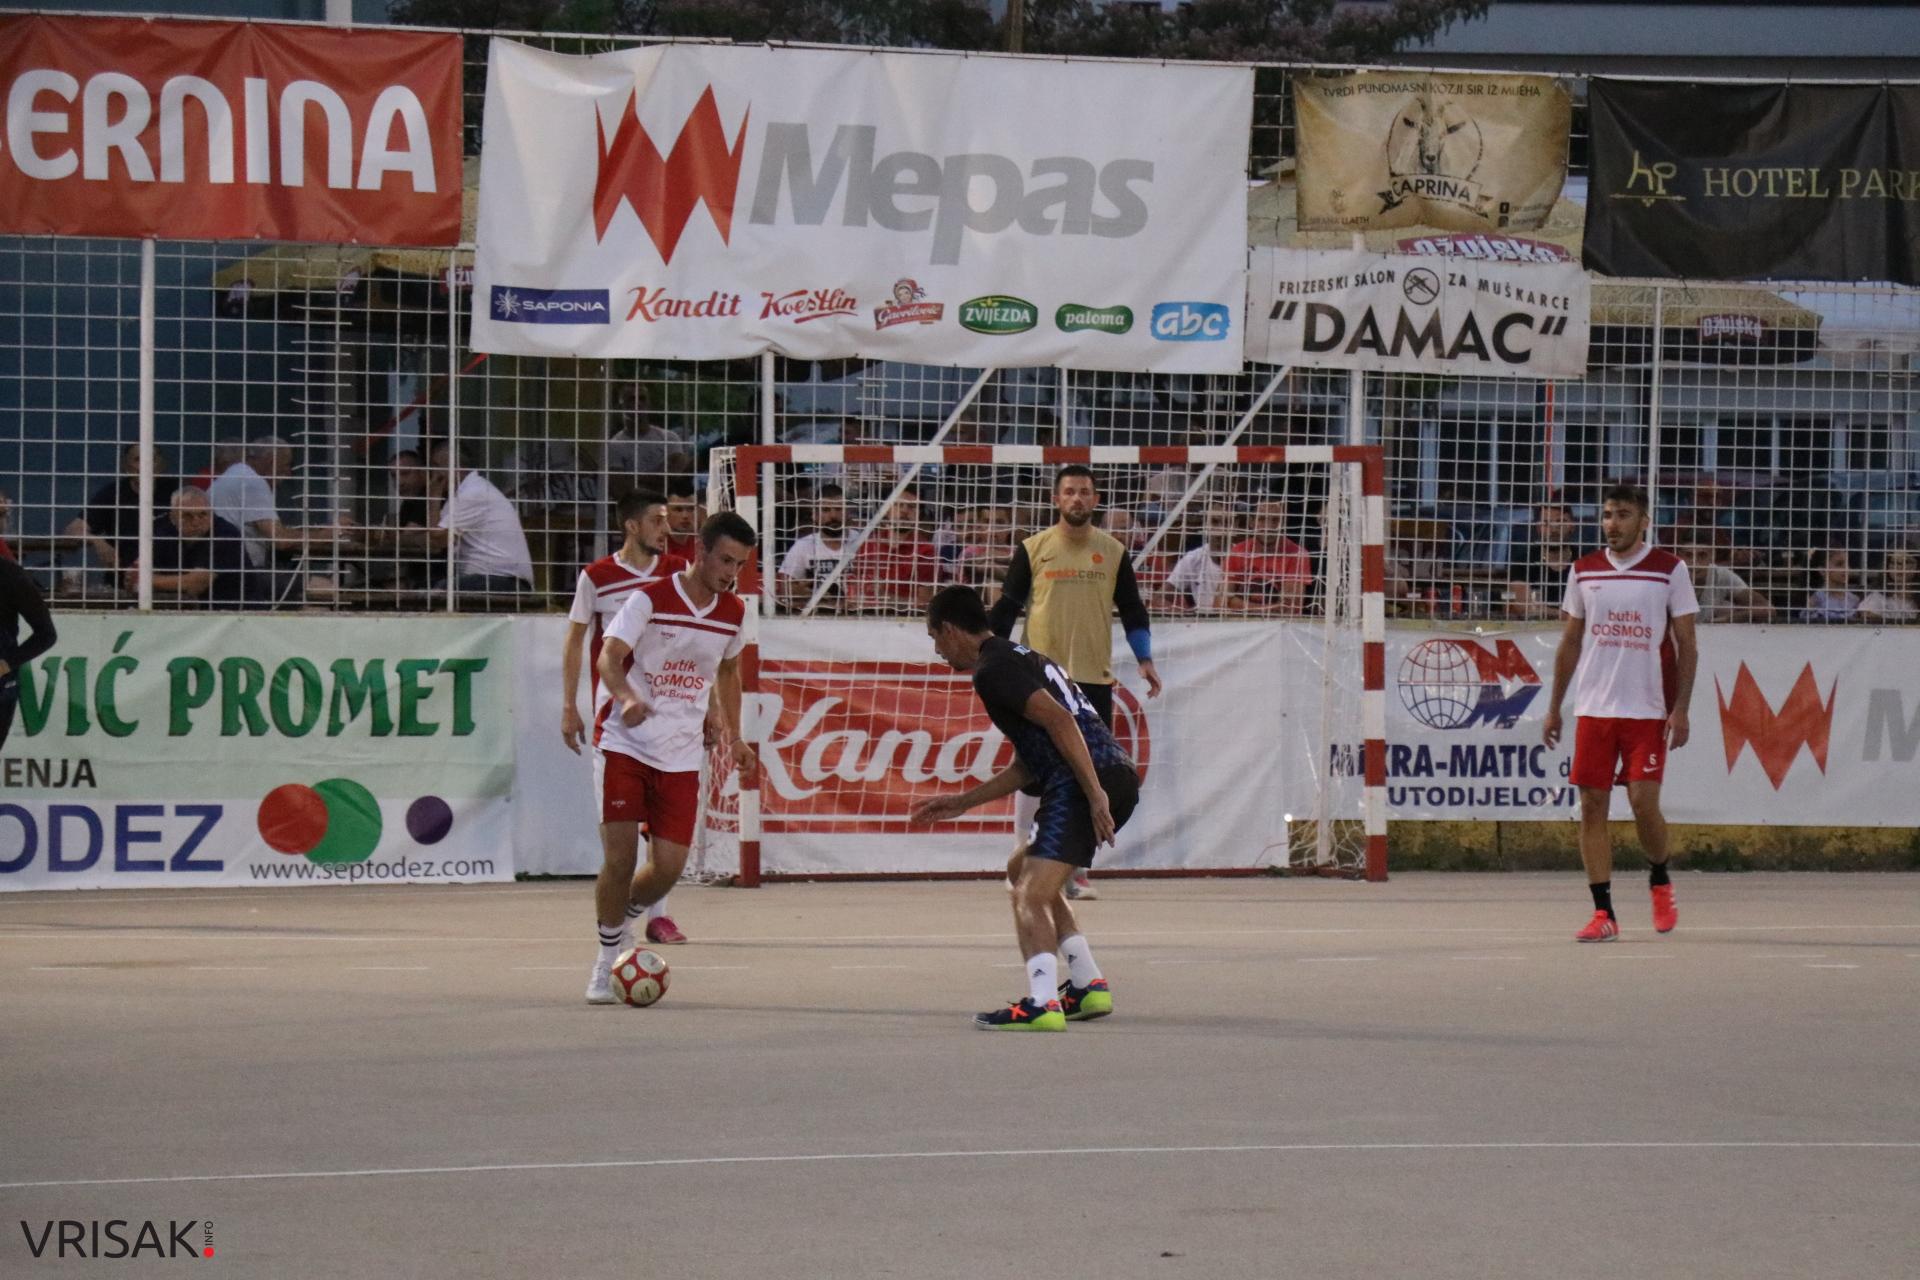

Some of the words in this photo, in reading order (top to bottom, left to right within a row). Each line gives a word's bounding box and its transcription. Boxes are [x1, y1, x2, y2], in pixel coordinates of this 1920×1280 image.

[1324, 86, 1355, 98] TVRDI
[1358, 82, 1427, 95] PUNOMASNI
[1430, 83, 1464, 95] KOZJI
[1467, 83, 1484, 96] SIR
[1487, 84, 1498, 96] IZ
[0, 69, 437, 193] ERNINA
[749, 122, 1155, 265] Mepas
[1391, 178, 1471, 202] CAPRINA
[1703, 167, 1829, 199] HOTEL
[522, 299, 606, 312] SAPONIA
[625, 286, 742, 323] Kandit
[759, 288, 858, 324] Koestlin
[1279, 276, 1348, 294] FRIZERSKI
[1354, 270, 1395, 286] SALON
[1448, 272, 1467, 288] ZA
[1478, 277, 1570, 311] MUŠKARCE
[965, 306, 1032, 324] ZVIJEZDA
[1065, 311, 1126, 327] paloma
[1156, 305, 1223, 337] abc
[1591, 623, 1652, 639] COSMOS
[1608, 609, 1642, 622] butik
[165, 655, 489, 738] PROMET
[0, 758, 97, 789] ENJA
[1329, 744, 1547, 778] MIRA-MATIC
[1385, 786, 1576, 808] UTODIJELOVI
[249, 855, 496, 882] www.septodez.com
